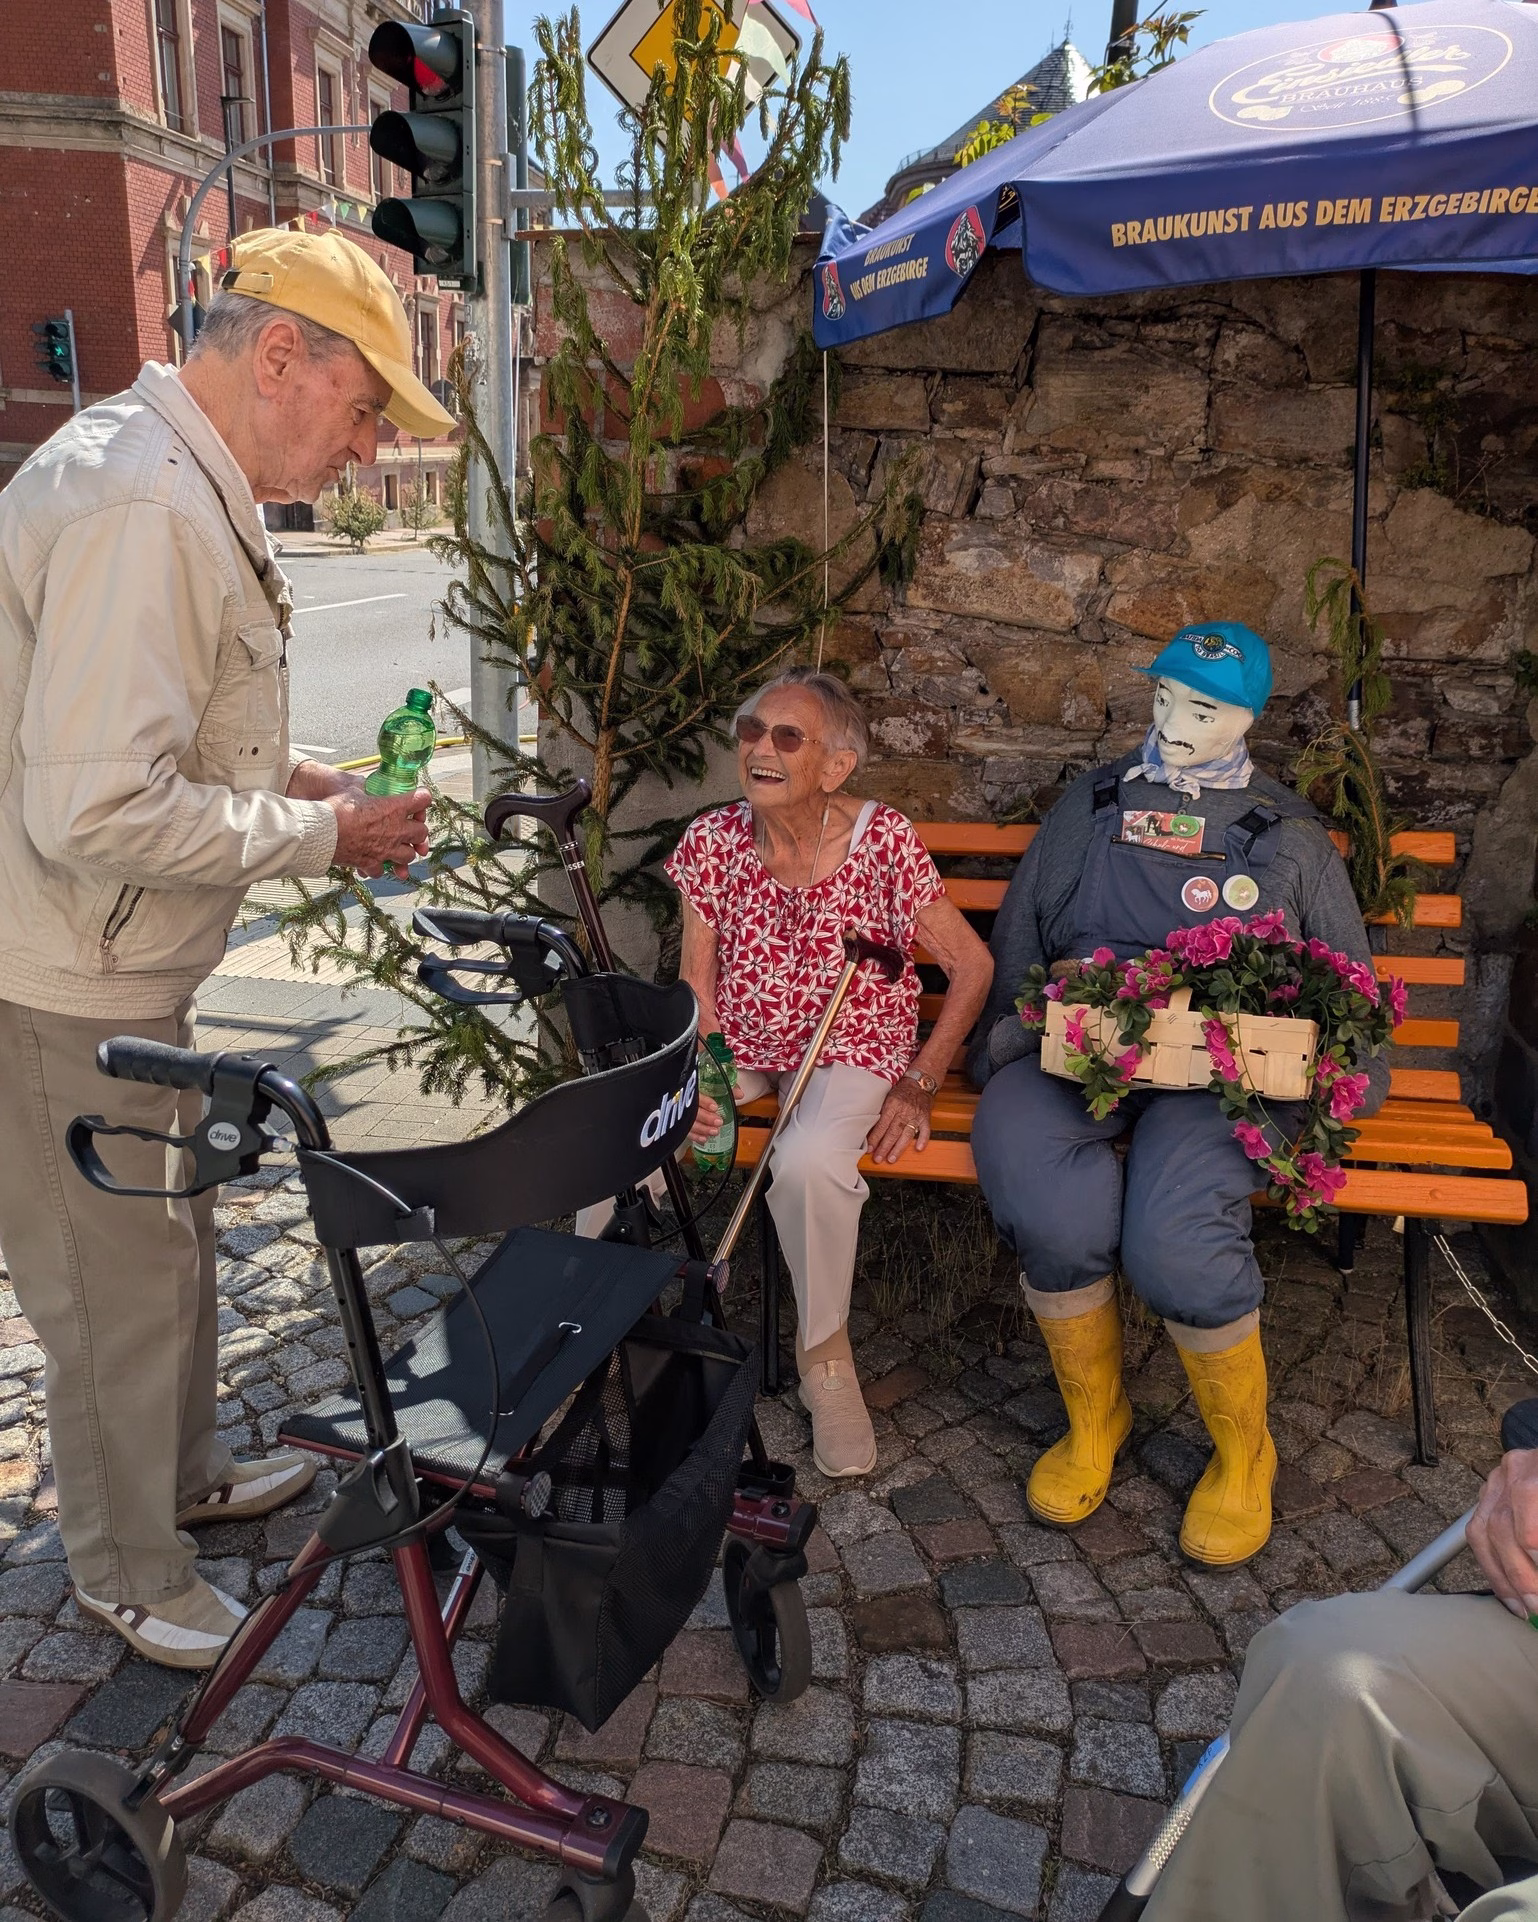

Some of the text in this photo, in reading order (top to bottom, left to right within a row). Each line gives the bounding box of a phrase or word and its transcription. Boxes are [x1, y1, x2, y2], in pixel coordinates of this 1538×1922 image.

[1231, 44, 1472, 104] Einsiedler
[1279, 76, 1423, 103] BRAUHAUS
[1111, 186, 1538, 248] BRAUKUNST AUS DEM ERZGEBIRGE
[864, 233, 916, 267] BRAUKUNST
[861, 273, 876, 296] DEM
[876, 257, 929, 290] ERZGEBIRGE
[640, 1069, 697, 1148] drive
[210, 1130, 237, 1142] drive
